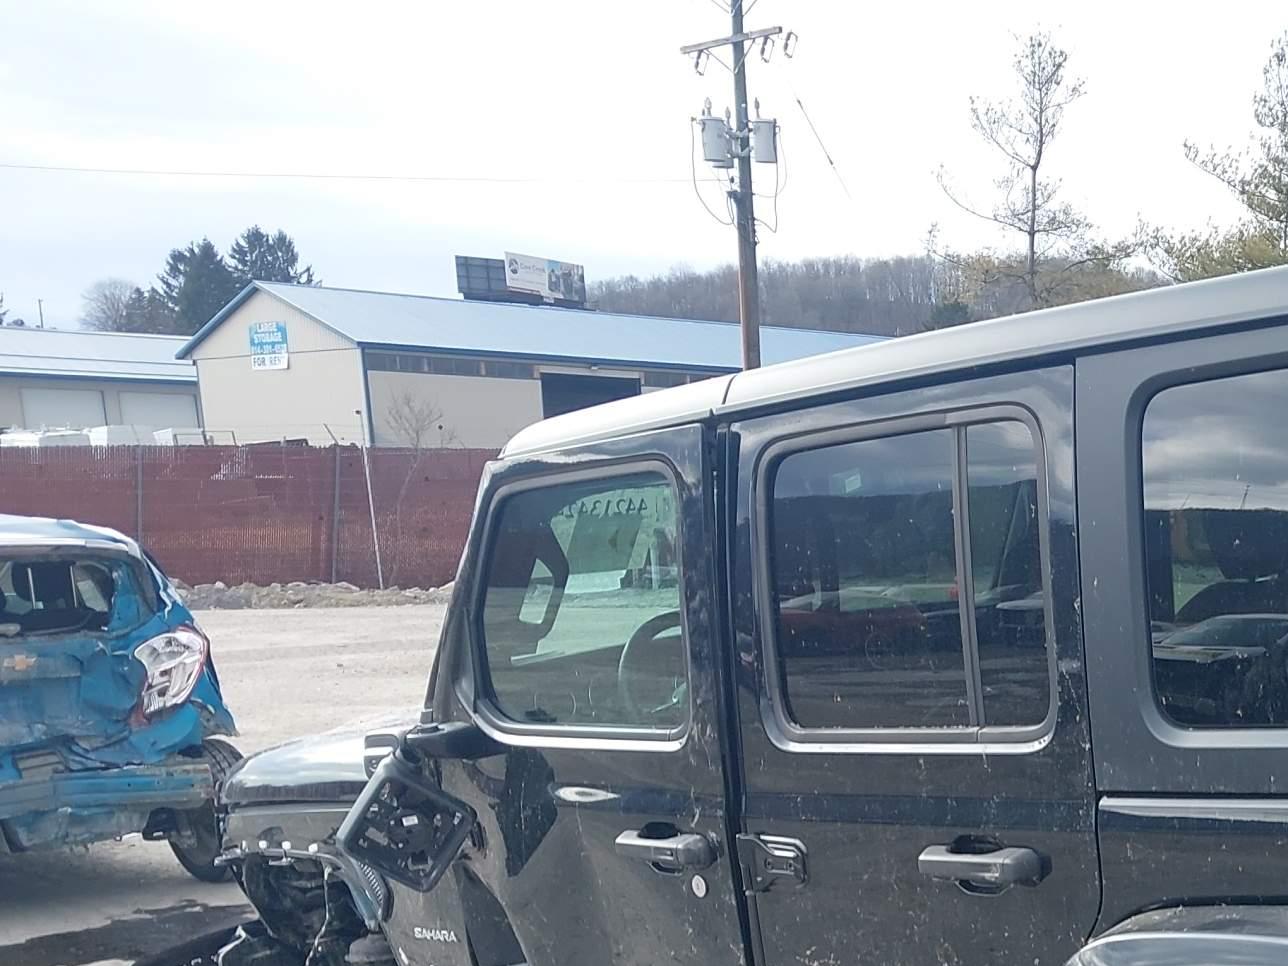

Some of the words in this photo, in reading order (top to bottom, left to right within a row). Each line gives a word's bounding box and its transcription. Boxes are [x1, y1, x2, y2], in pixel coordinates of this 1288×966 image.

[256, 322, 277, 332] LARGE
[253, 332, 282, 343] STORAGE
[253, 357, 266, 367] FOR
[414, 927, 458, 942] SAHARA
